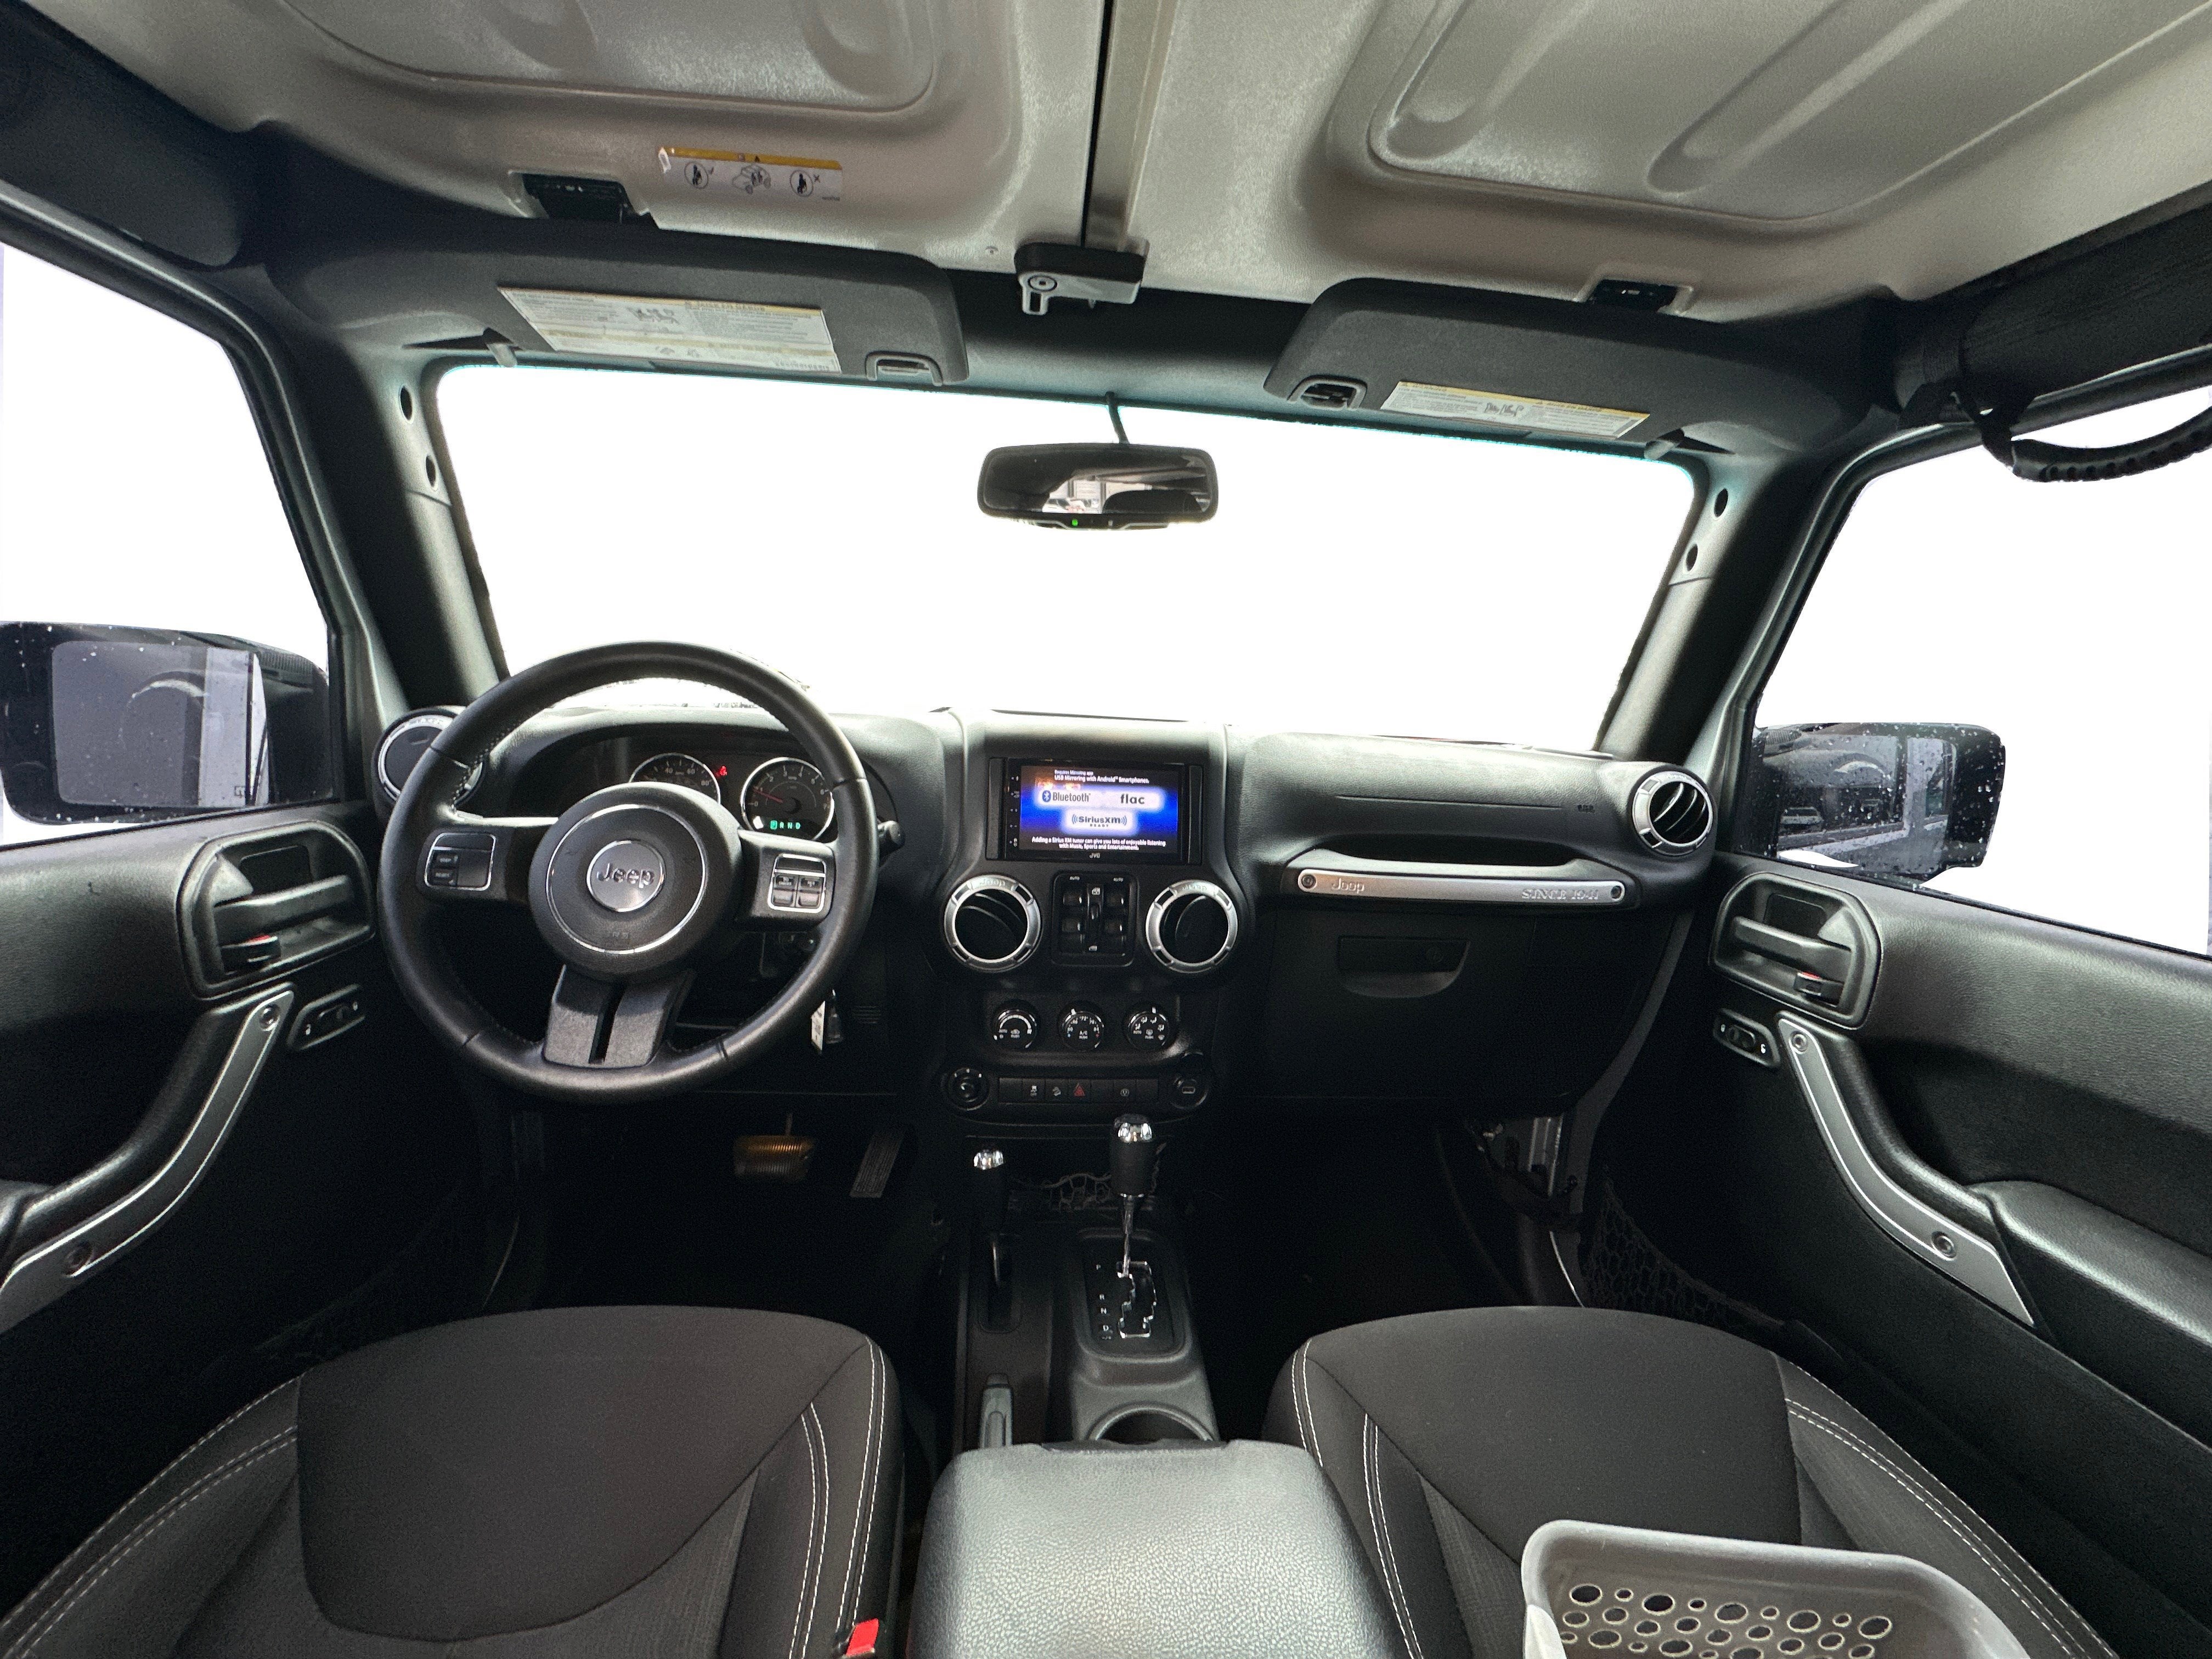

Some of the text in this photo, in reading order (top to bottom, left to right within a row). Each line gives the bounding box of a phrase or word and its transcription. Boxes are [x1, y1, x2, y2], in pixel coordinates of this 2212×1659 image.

[1052, 792, 1089, 802] Bluetooth
[1120, 793, 1145, 804] flac
[596, 862, 654, 888] Jeep
[1331, 878, 1364, 894] Jeep
